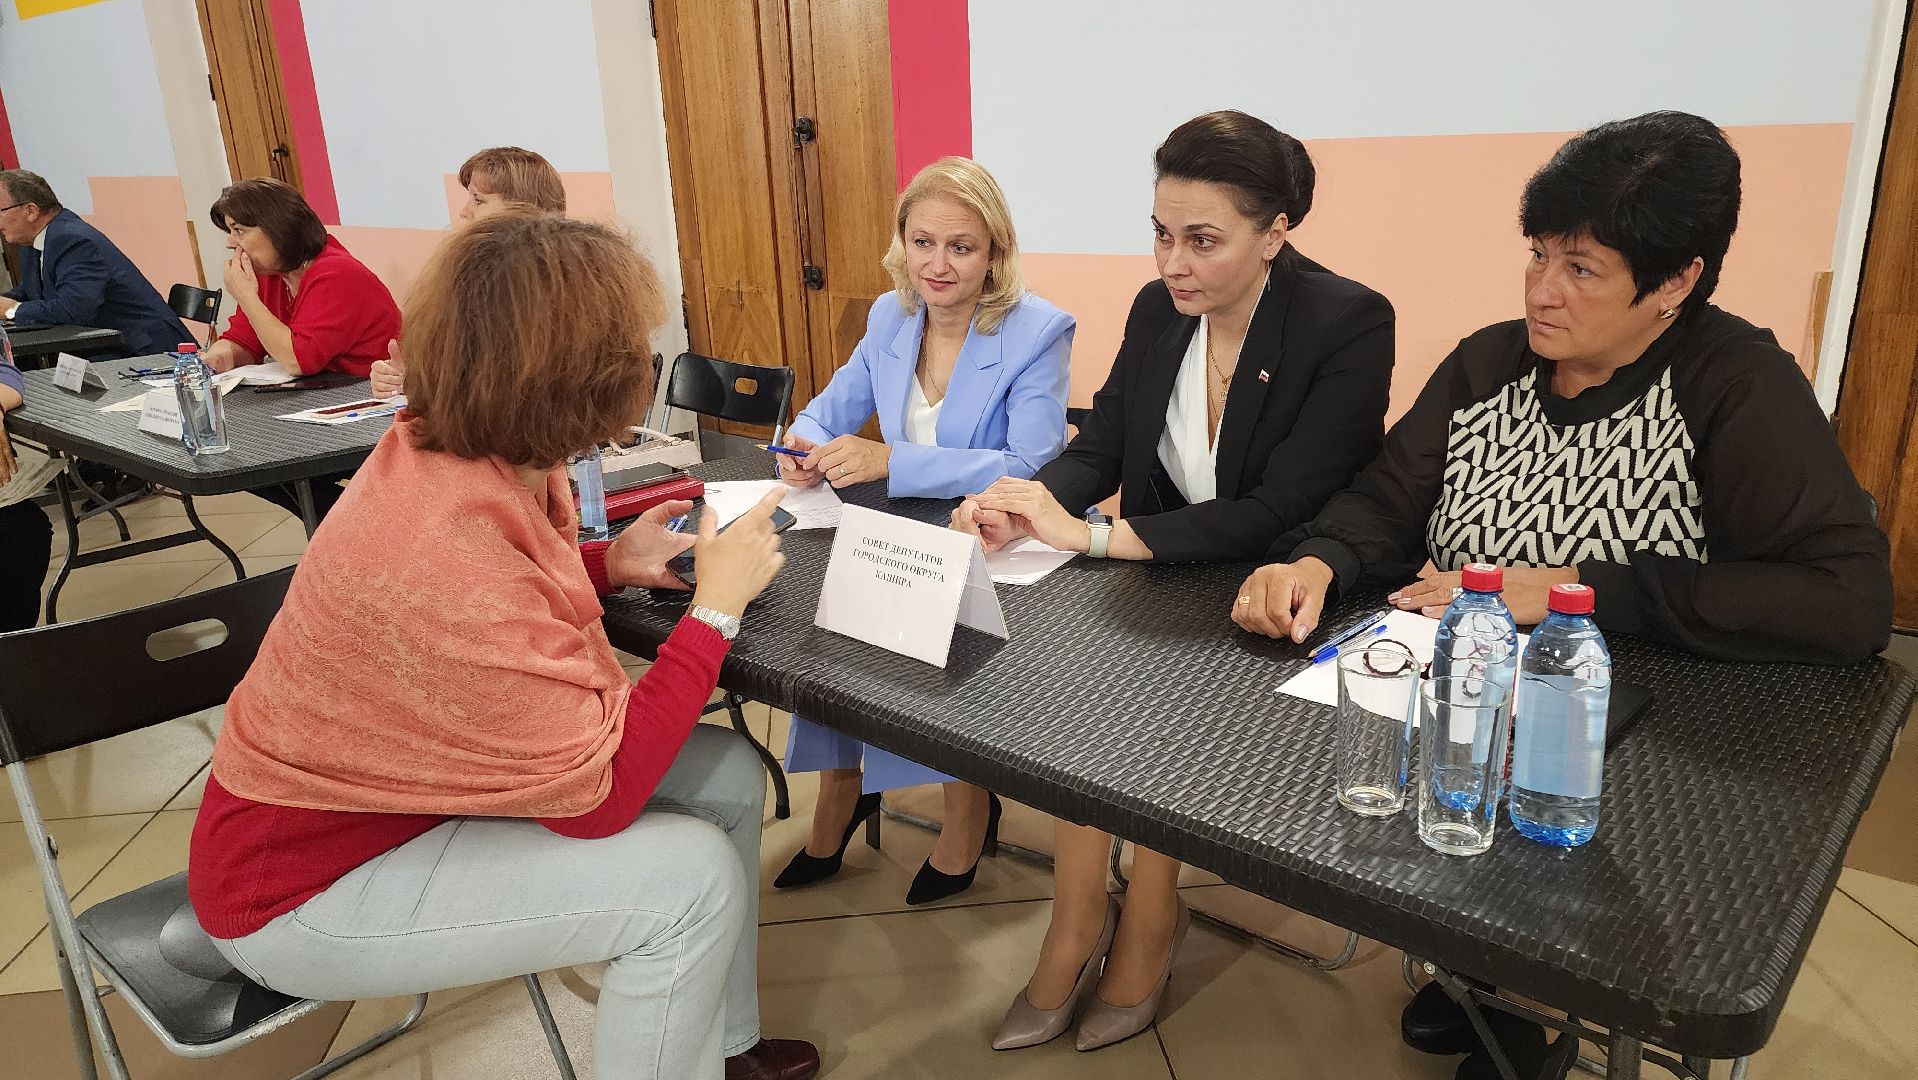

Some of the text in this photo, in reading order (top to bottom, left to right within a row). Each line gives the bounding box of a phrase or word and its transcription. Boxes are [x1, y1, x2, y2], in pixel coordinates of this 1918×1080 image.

[853, 548, 945, 583] ГОРОДСКОГО ОКРУГА
[862, 536, 943, 566] СОВЕТ ДЕПУТАТОВ
[875, 570, 912, 588] КАШИРА
